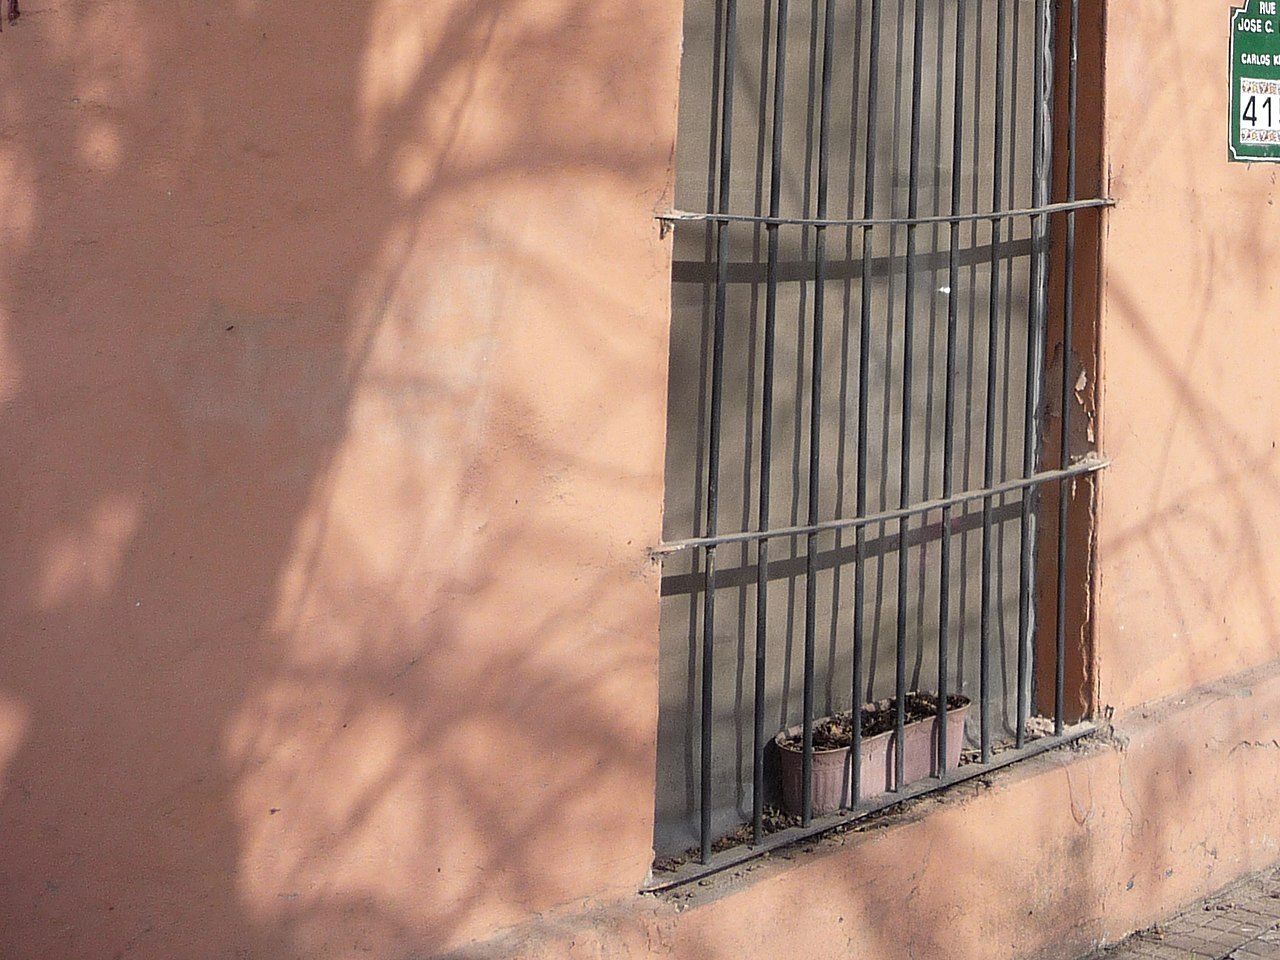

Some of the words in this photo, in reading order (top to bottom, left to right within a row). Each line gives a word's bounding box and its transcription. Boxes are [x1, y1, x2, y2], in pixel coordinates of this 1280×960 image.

[1259, 1, 1276, 15] RUE
[1238, 18, 1262, 33] JOSE
[1265, 21, 1274, 33] C.
[1241, 53, 1270, 66] CARLOS
